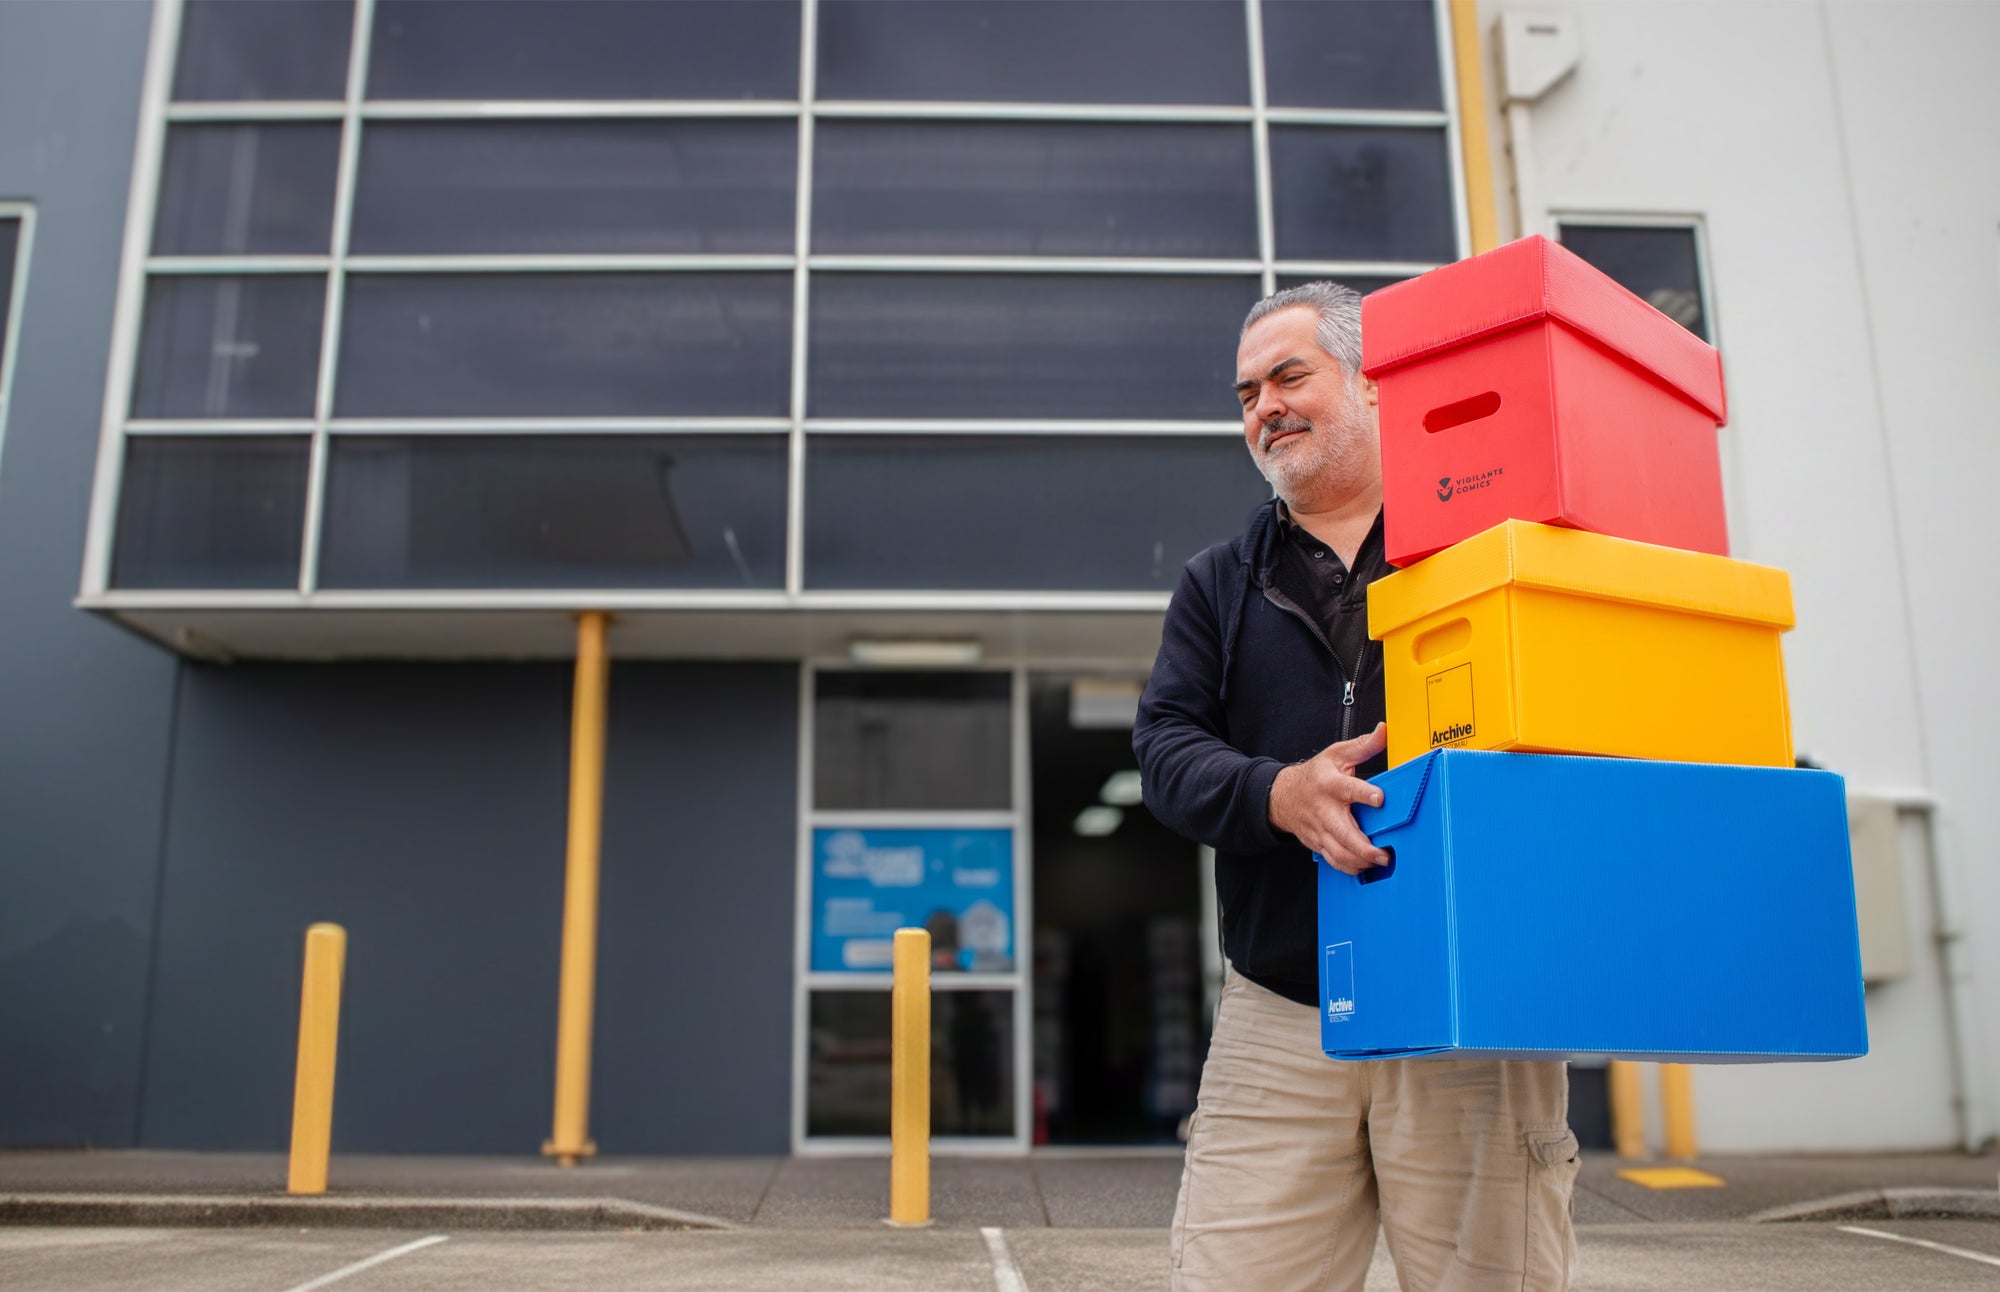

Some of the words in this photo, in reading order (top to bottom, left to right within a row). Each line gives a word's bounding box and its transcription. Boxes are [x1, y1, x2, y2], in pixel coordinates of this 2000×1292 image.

[1456, 467, 1503, 485] VIGILANTE
[1456, 480, 1491, 494] COMICS
[1432, 723, 1472, 745] Archive
[1329, 997, 1353, 1013] Archive
